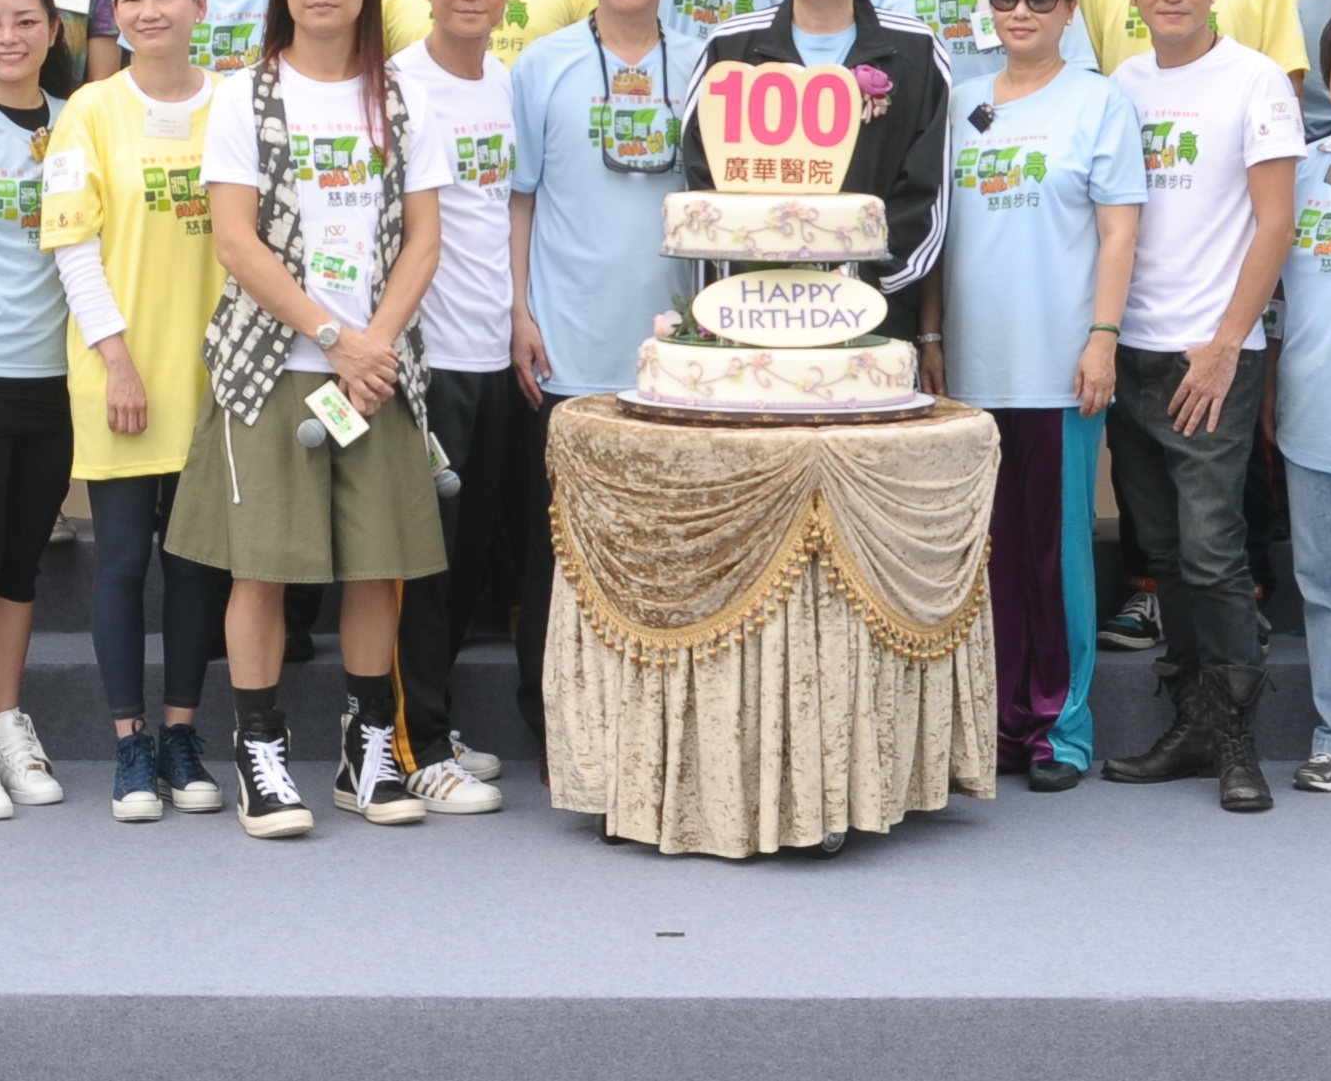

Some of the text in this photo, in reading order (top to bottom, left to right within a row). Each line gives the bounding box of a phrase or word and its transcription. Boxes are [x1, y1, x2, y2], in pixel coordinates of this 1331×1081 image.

[709, 70, 852, 148] 100
[1177, 130, 1199, 166] 高
[723, 157, 834, 186] 廣華醫院
[1022, 150, 1047, 184] 高
[987, 191, 1041, 212] 慈善步行
[719, 306, 867, 330] BIRTHDAY
